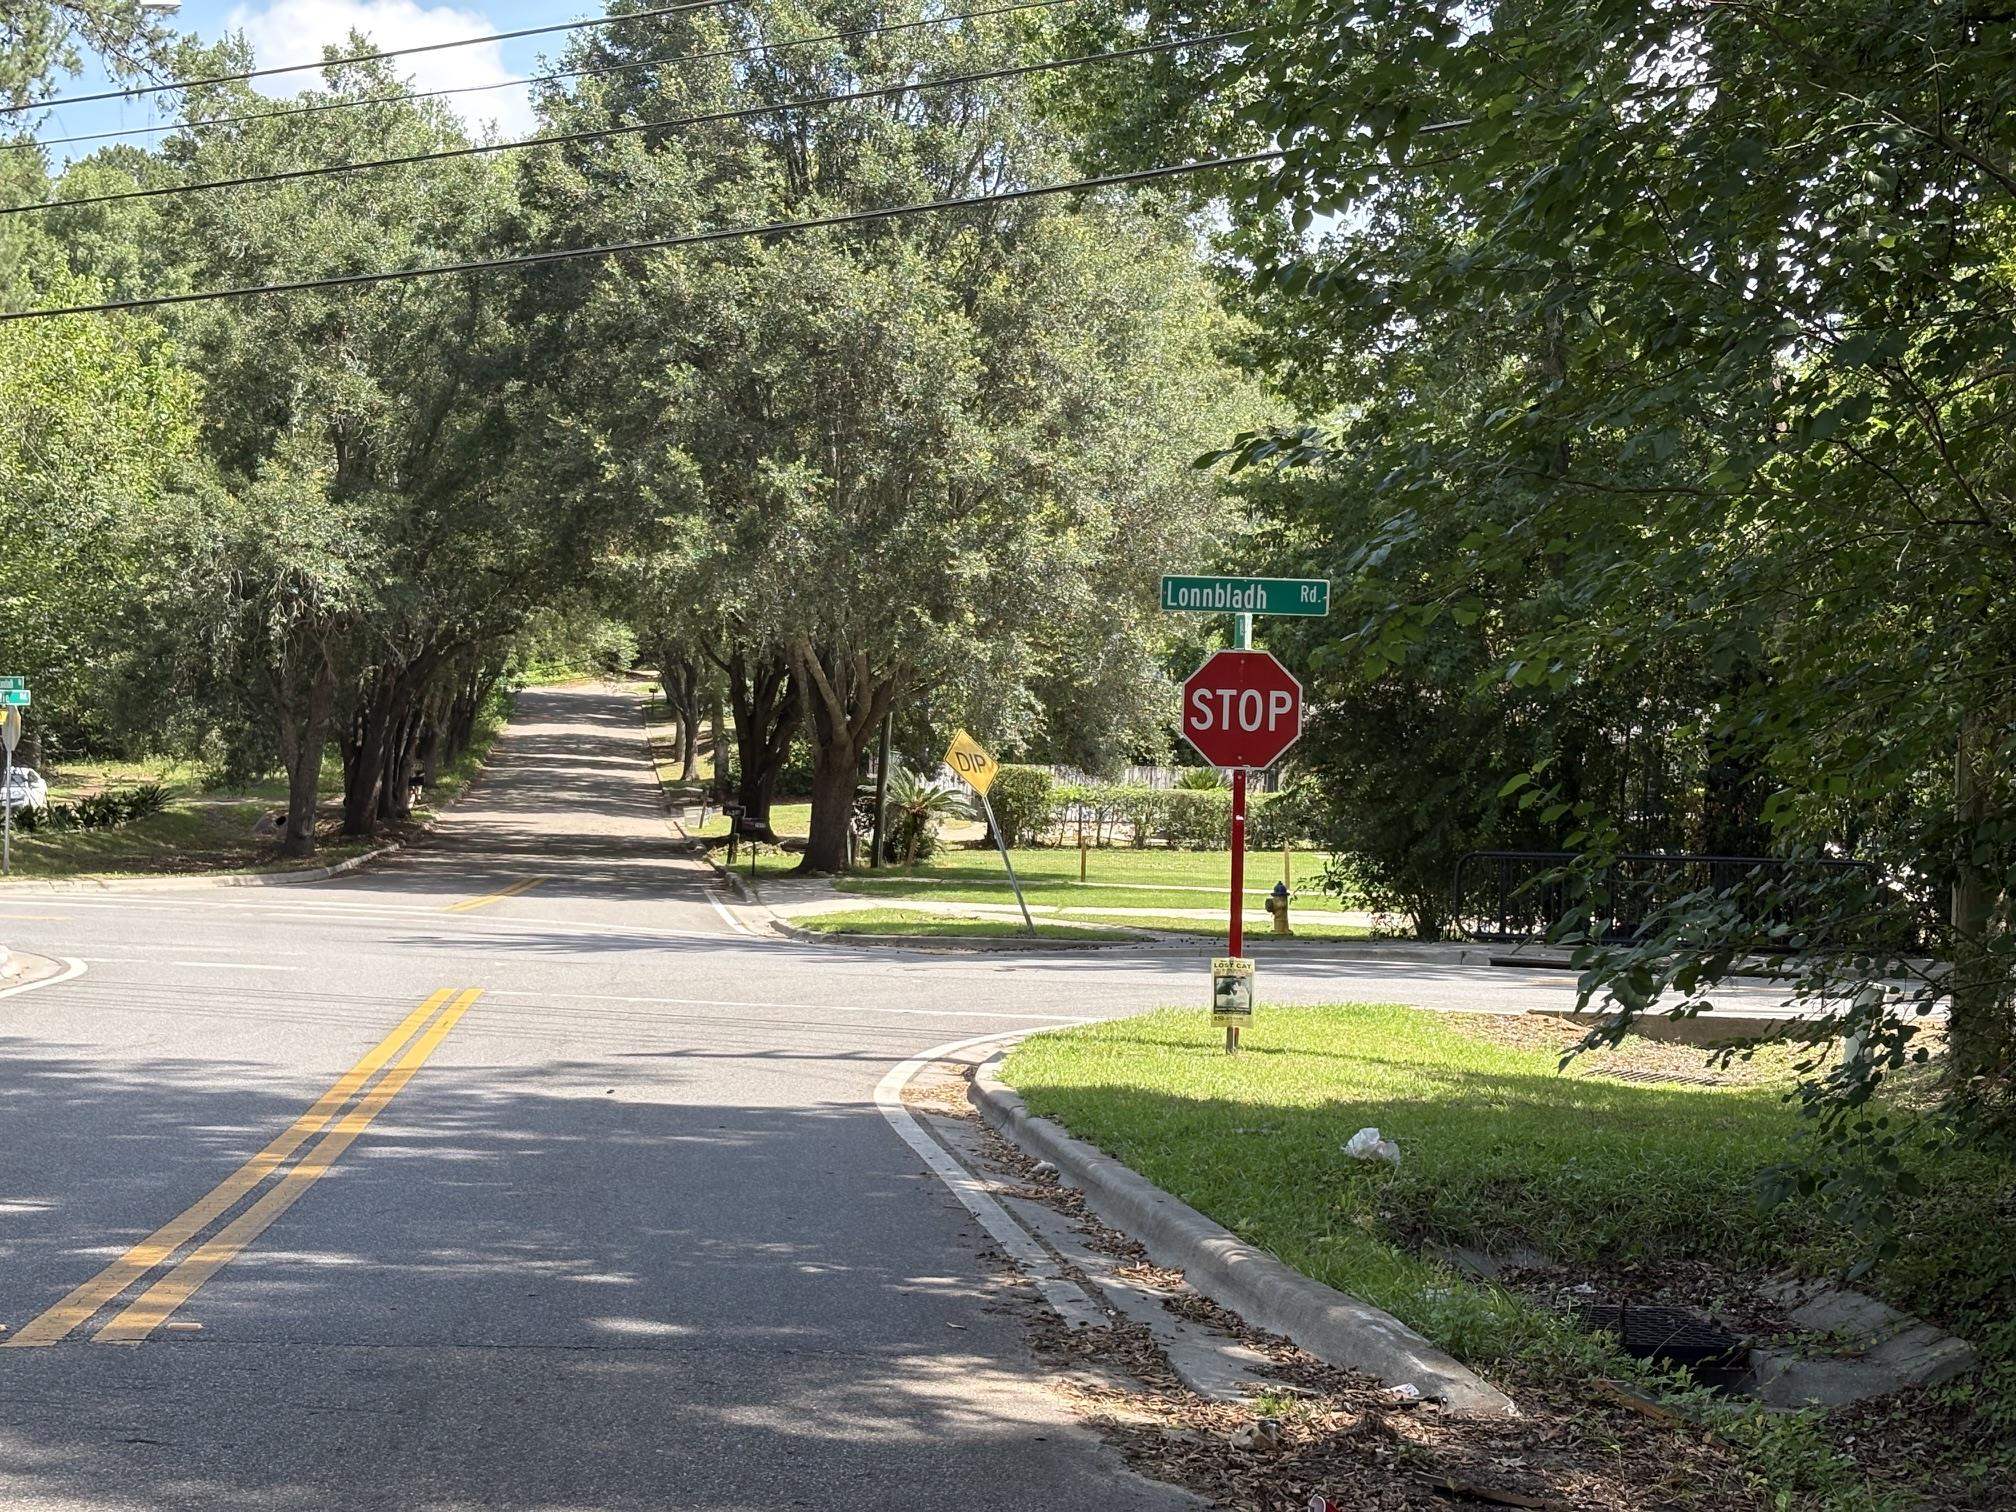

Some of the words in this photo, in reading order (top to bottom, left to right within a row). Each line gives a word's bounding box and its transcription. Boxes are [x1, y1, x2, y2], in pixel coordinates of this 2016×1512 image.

[1167, 581, 1267, 609] Lonnbladh
[1300, 585, 1321, 603] Rd.
[1190, 688, 1293, 732] STOP
[955, 752, 986, 773] DIP
